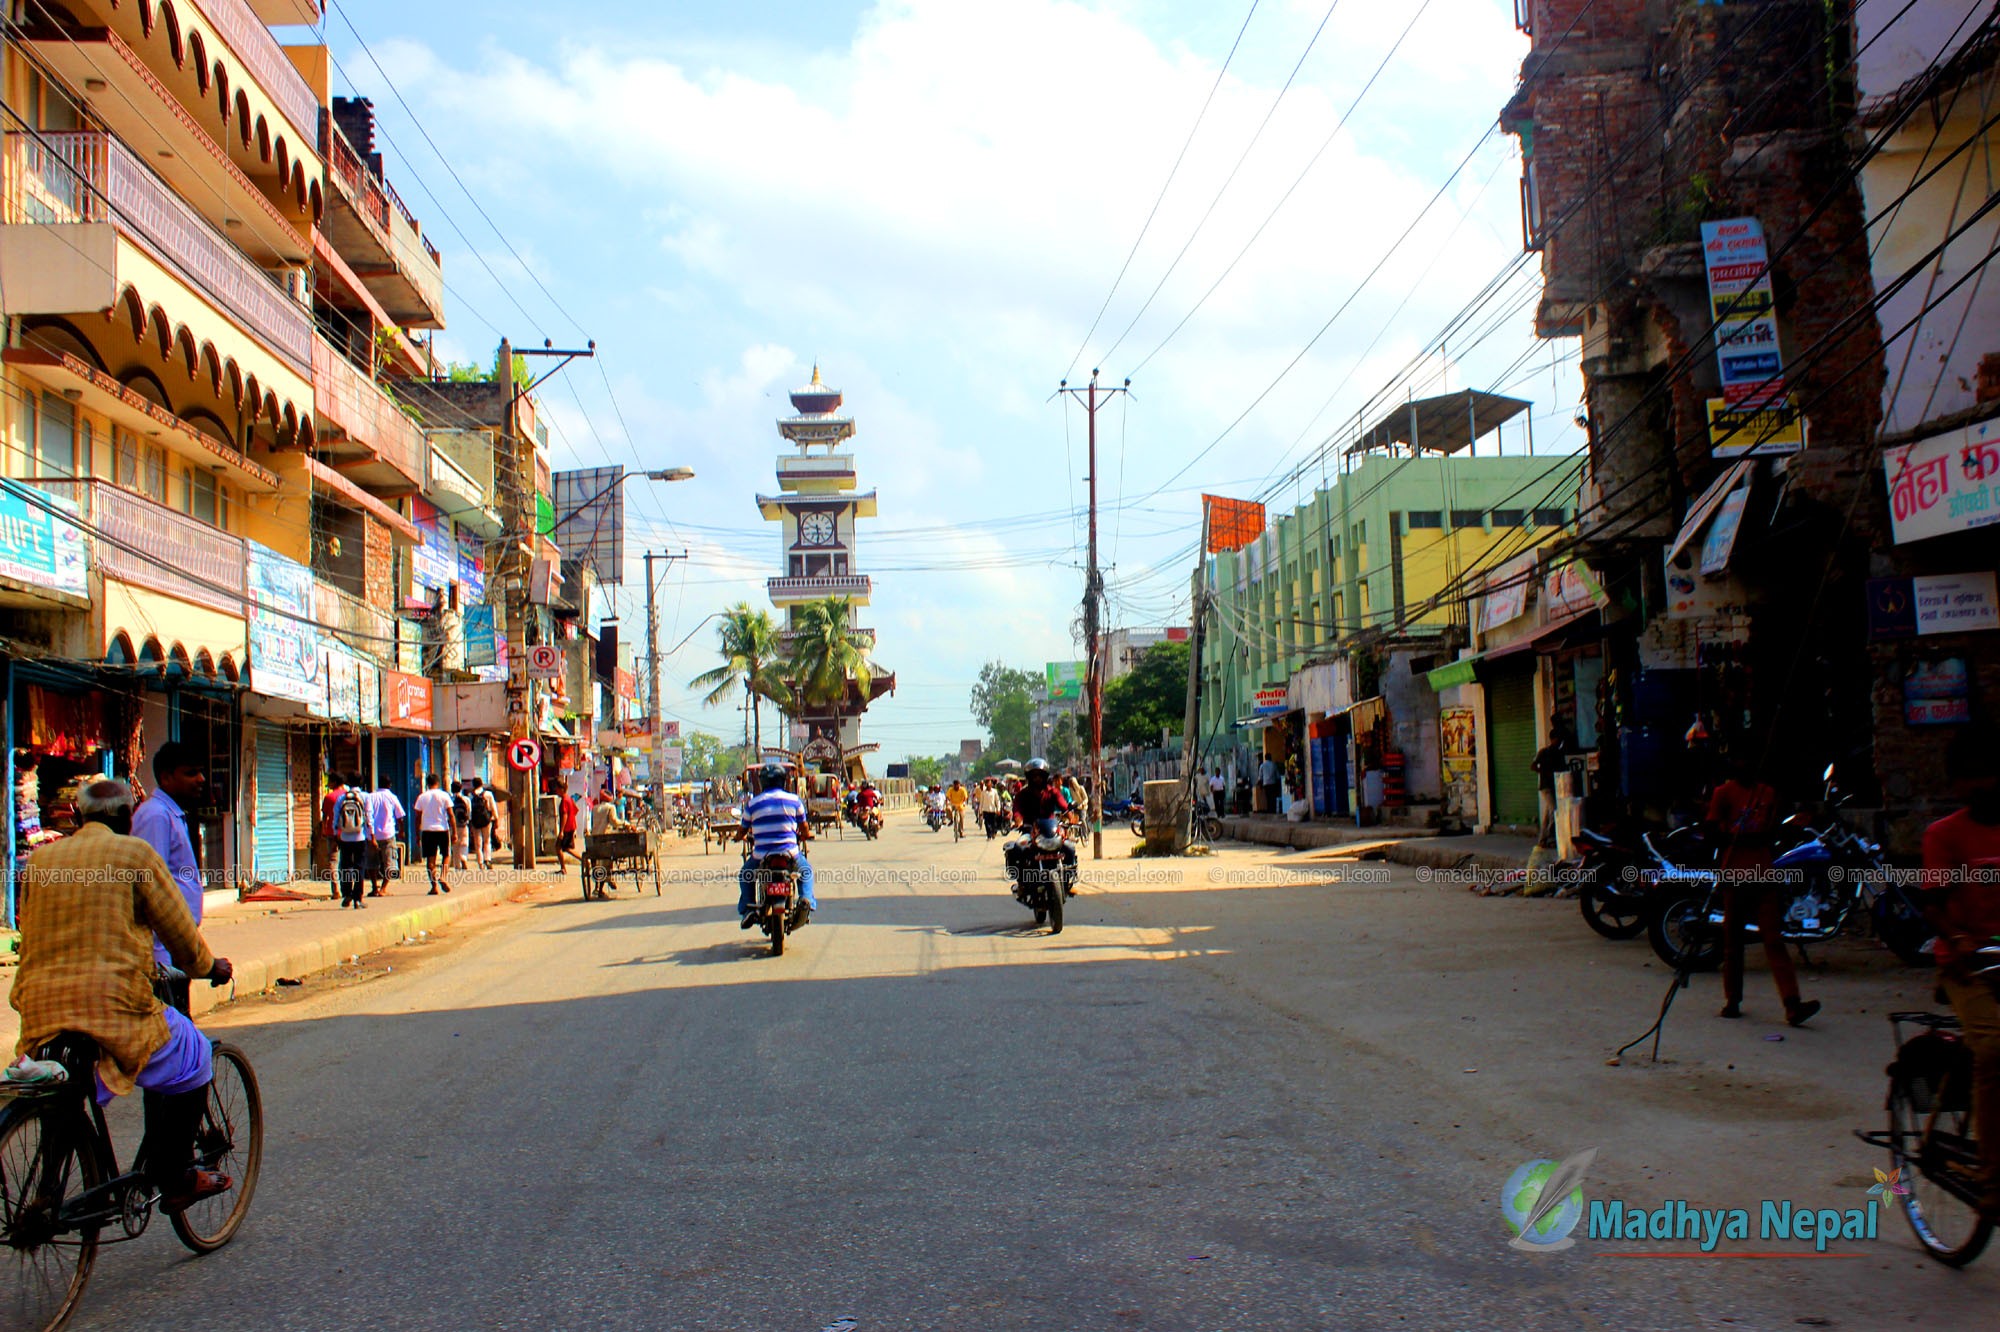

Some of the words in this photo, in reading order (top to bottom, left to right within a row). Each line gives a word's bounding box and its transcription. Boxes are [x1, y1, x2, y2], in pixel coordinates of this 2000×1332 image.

[1960, 438, 2000, 481] फ
[0, 511, 48, 555] LIFE
[9, 562, 56, 587] Enterprises
[516, 745, 533, 763] P
